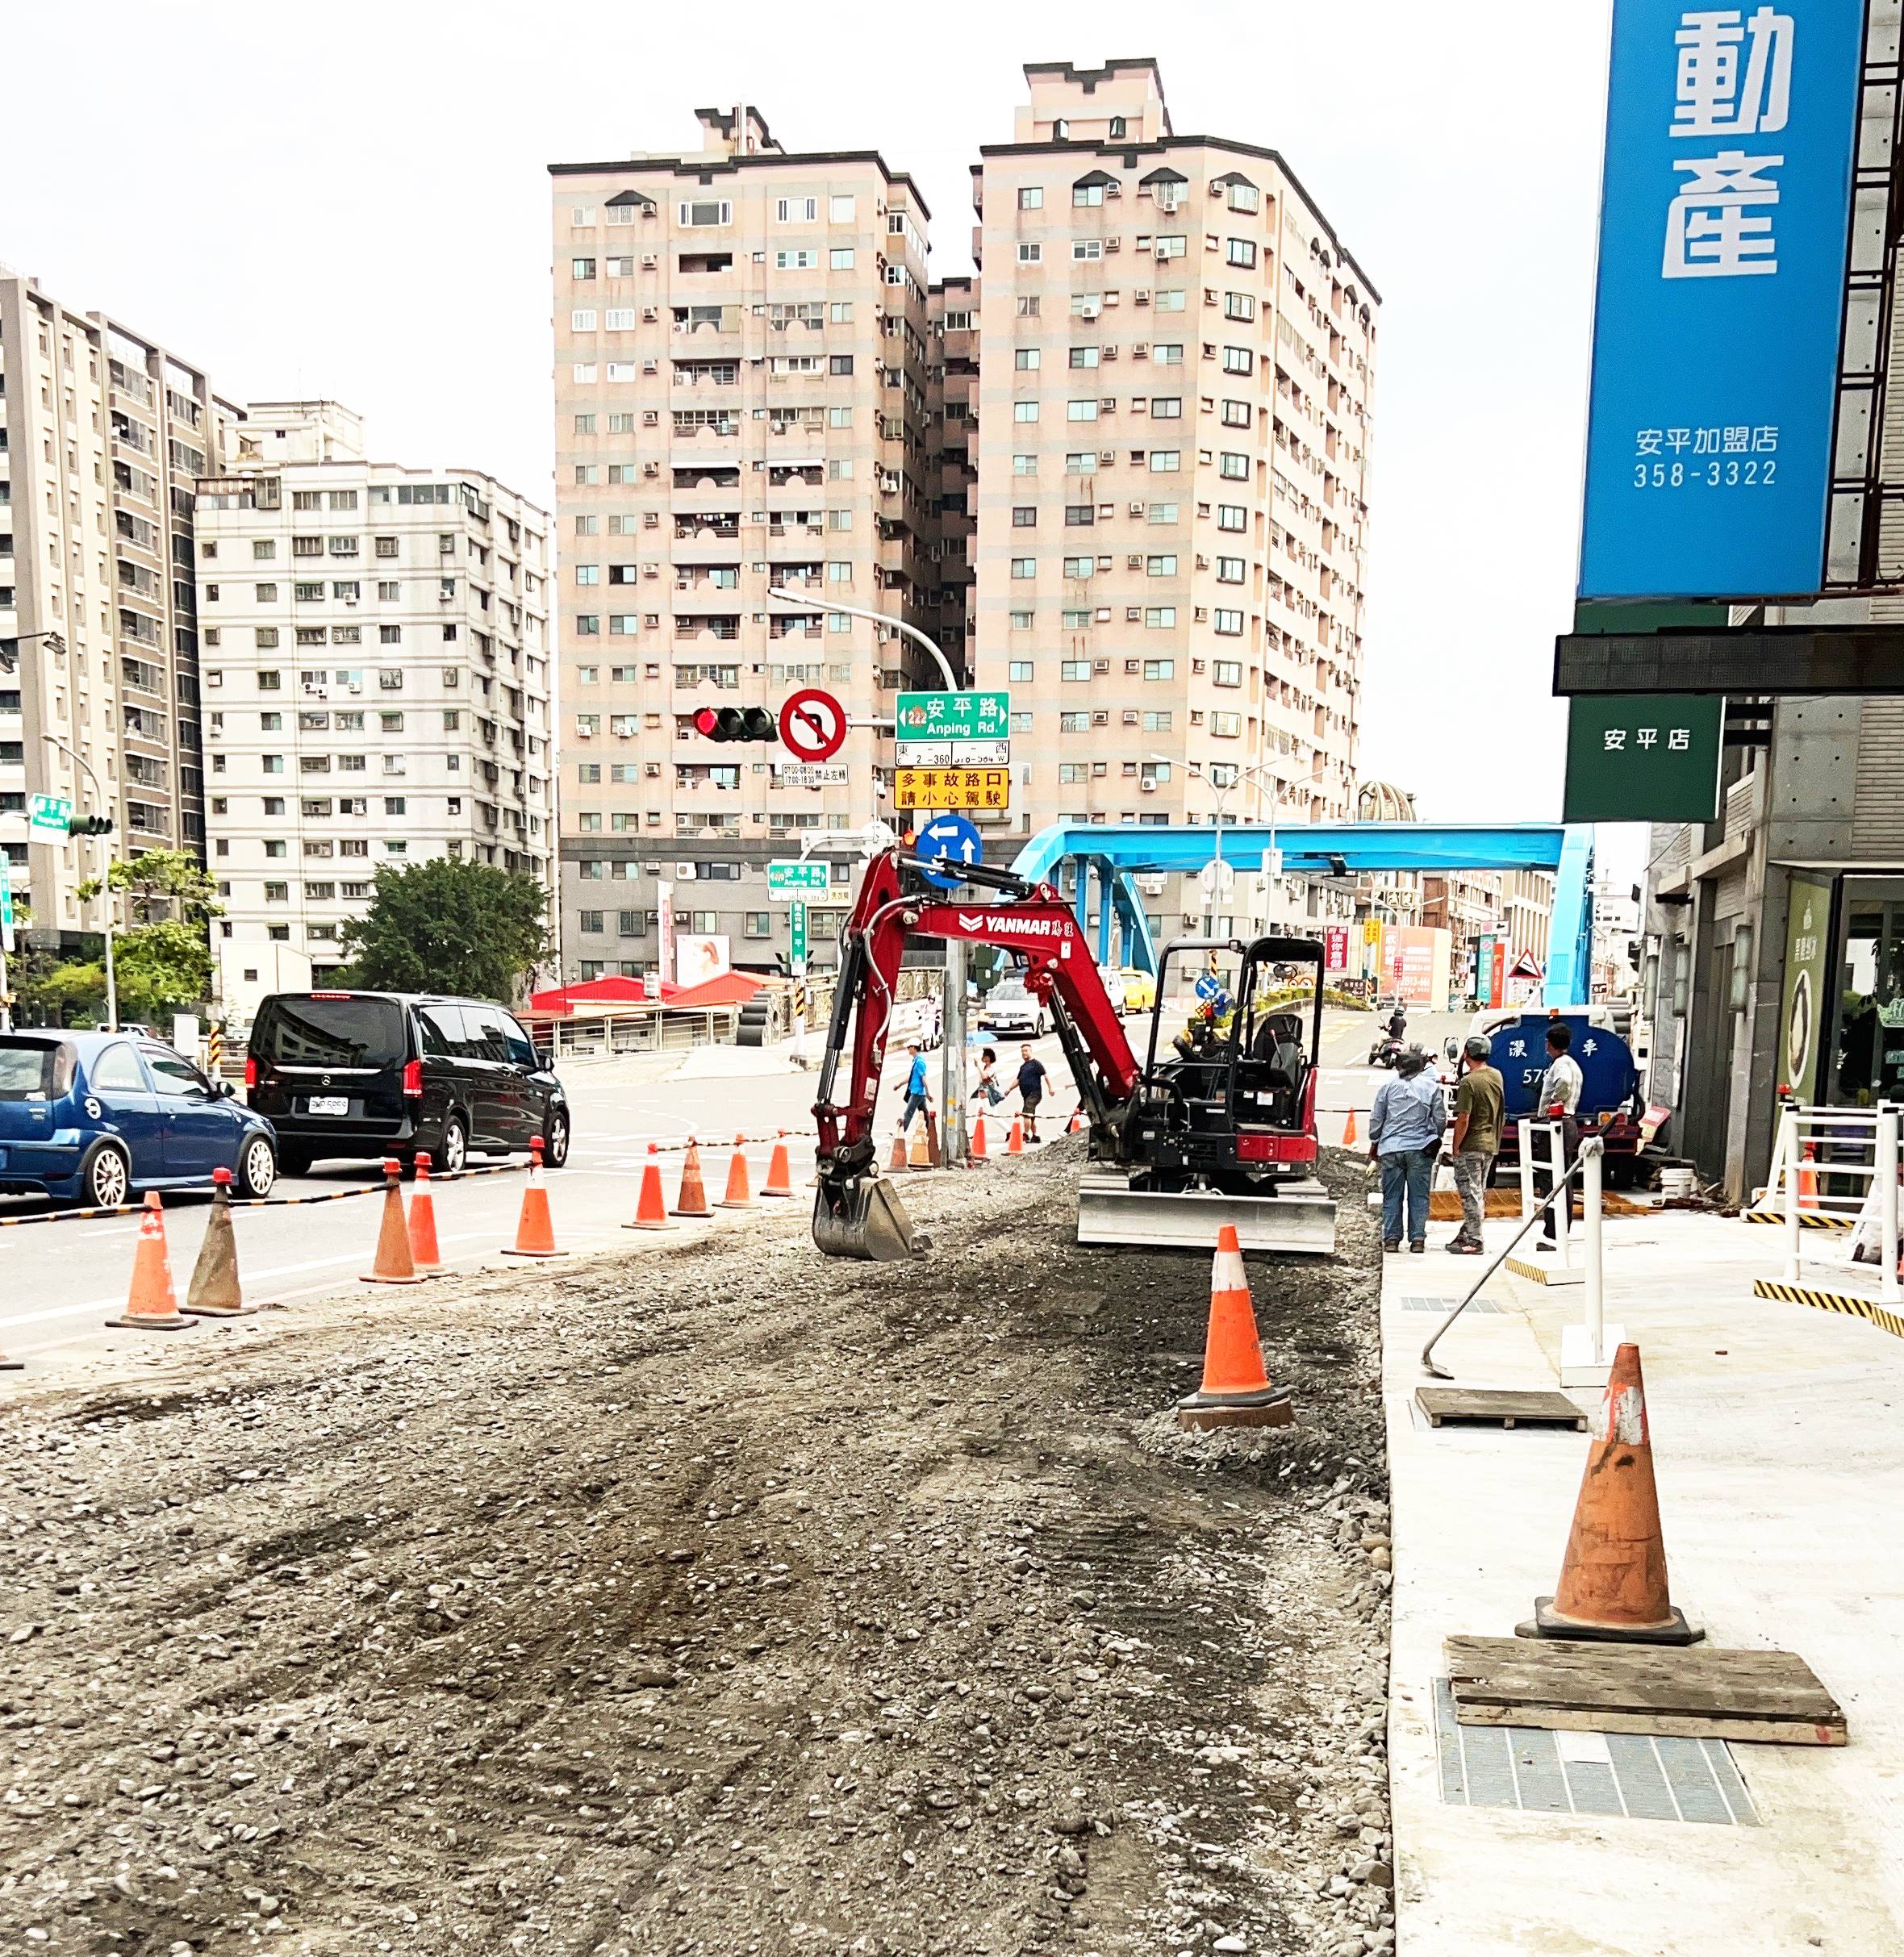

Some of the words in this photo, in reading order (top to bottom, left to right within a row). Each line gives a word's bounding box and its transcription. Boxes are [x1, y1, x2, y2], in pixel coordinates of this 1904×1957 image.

[1661, 6, 1794, 279] 動產
[1635, 425, 1780, 456] 安平加盟店
[1633, 460, 1777, 488] 358-3322
[927, 697, 998, 720] 安平路
[927, 722, 971, 736] Anping
[978, 721, 998, 733] Rd.
[1604, 728, 1690, 750] 安平店
[996, 741, 1007, 753] 西
[902, 772, 1001, 787] 多事故路口
[901, 790, 1000, 806] 請小心駕駛
[986, 916, 1051, 936] YANMAR
